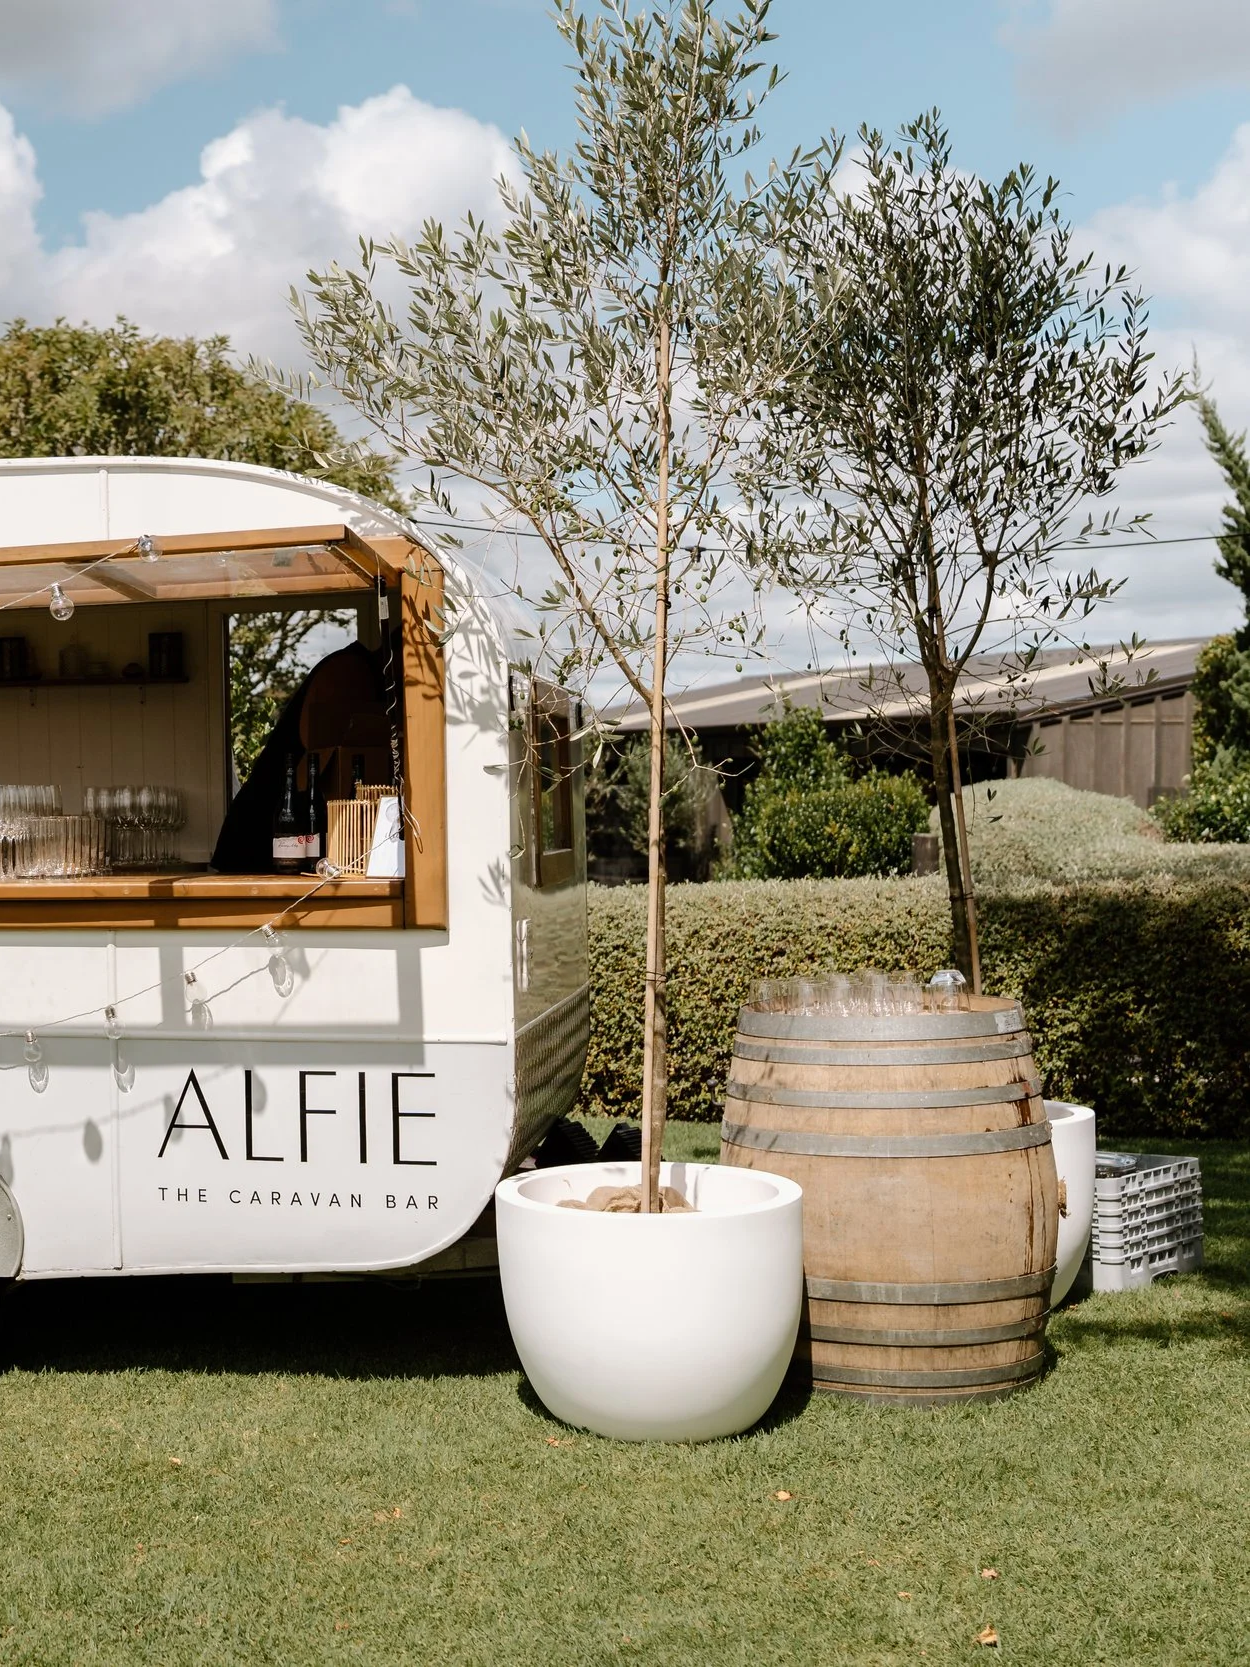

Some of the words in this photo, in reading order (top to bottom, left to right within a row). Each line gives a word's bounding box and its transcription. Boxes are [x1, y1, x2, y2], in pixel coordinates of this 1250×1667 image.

[157, 1068, 438, 1166] ALFIE
[158, 1187, 207, 1203] THE
[229, 1189, 362, 1208] CARAVAN
[385, 1194, 439, 1210] BAR
